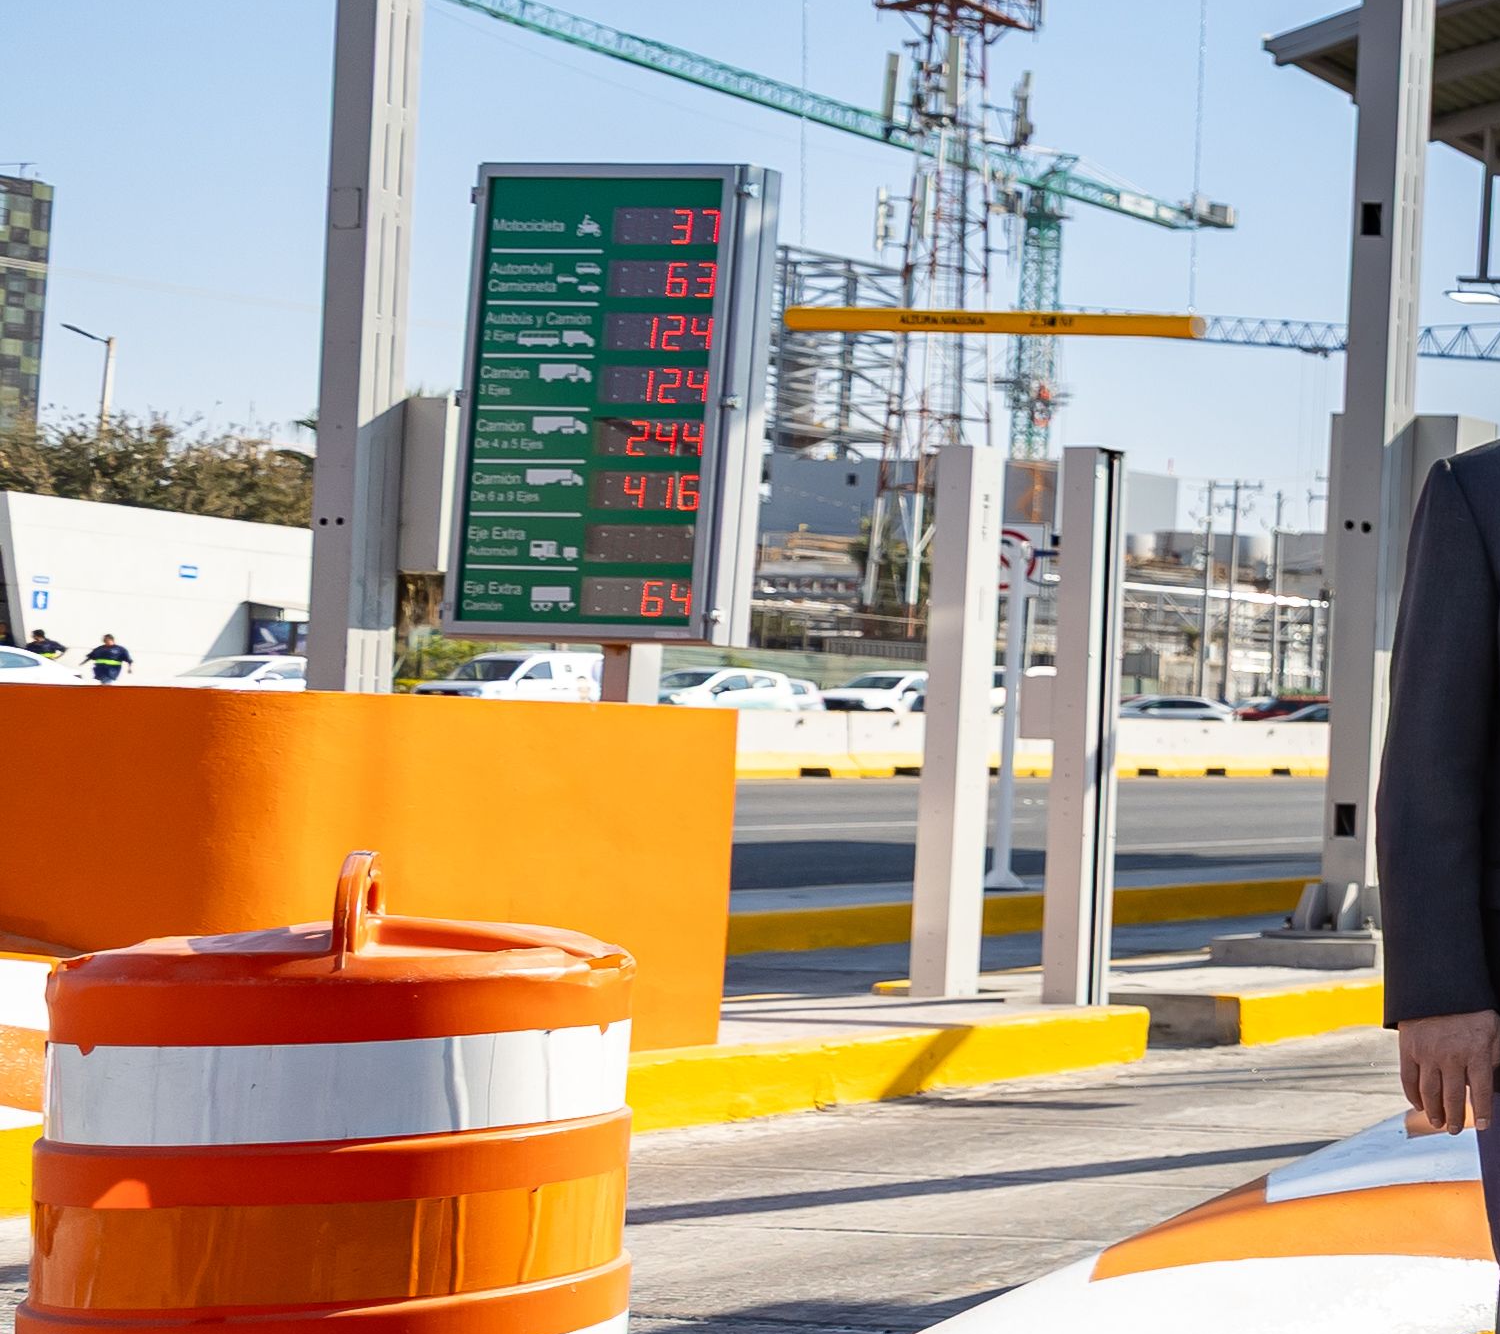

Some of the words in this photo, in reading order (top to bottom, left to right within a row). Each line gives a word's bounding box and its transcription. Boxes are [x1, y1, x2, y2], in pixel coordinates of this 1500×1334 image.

[493, 218, 566, 232] Motocicleta
[671, 209, 721, 245] 37
[489, 262, 554, 275] Automóvil
[488, 279, 557, 292] Camioneta
[665, 262, 718, 297] 63
[535, 315, 544, 328] y
[546, 312, 592, 325] Camión
[483, 330, 492, 341] 2
[493, 330, 517, 343] Ejes
[649, 315, 714, 351] 124
[480, 365, 530, 379] Camión
[646, 368, 710, 404] 124
[476, 418, 526, 432] Camión
[491, 438, 499, 448] 4
[501, 440, 509, 449] a
[510, 438, 518, 448] 5
[625, 420, 705, 456] 244
[472, 472, 521, 485] Camión
[471, 490, 486, 502] De
[487, 491, 495, 502] 6
[497, 492, 505, 502] a
[516, 490, 539, 504] Ejes
[623, 474, 700, 511] 416
[468, 525, 489, 542] Eje
[491, 526, 526, 540] Extra
[464, 580, 485, 596] Eje
[488, 581, 522, 595] Extra
[640, 581, 692, 616] 64
